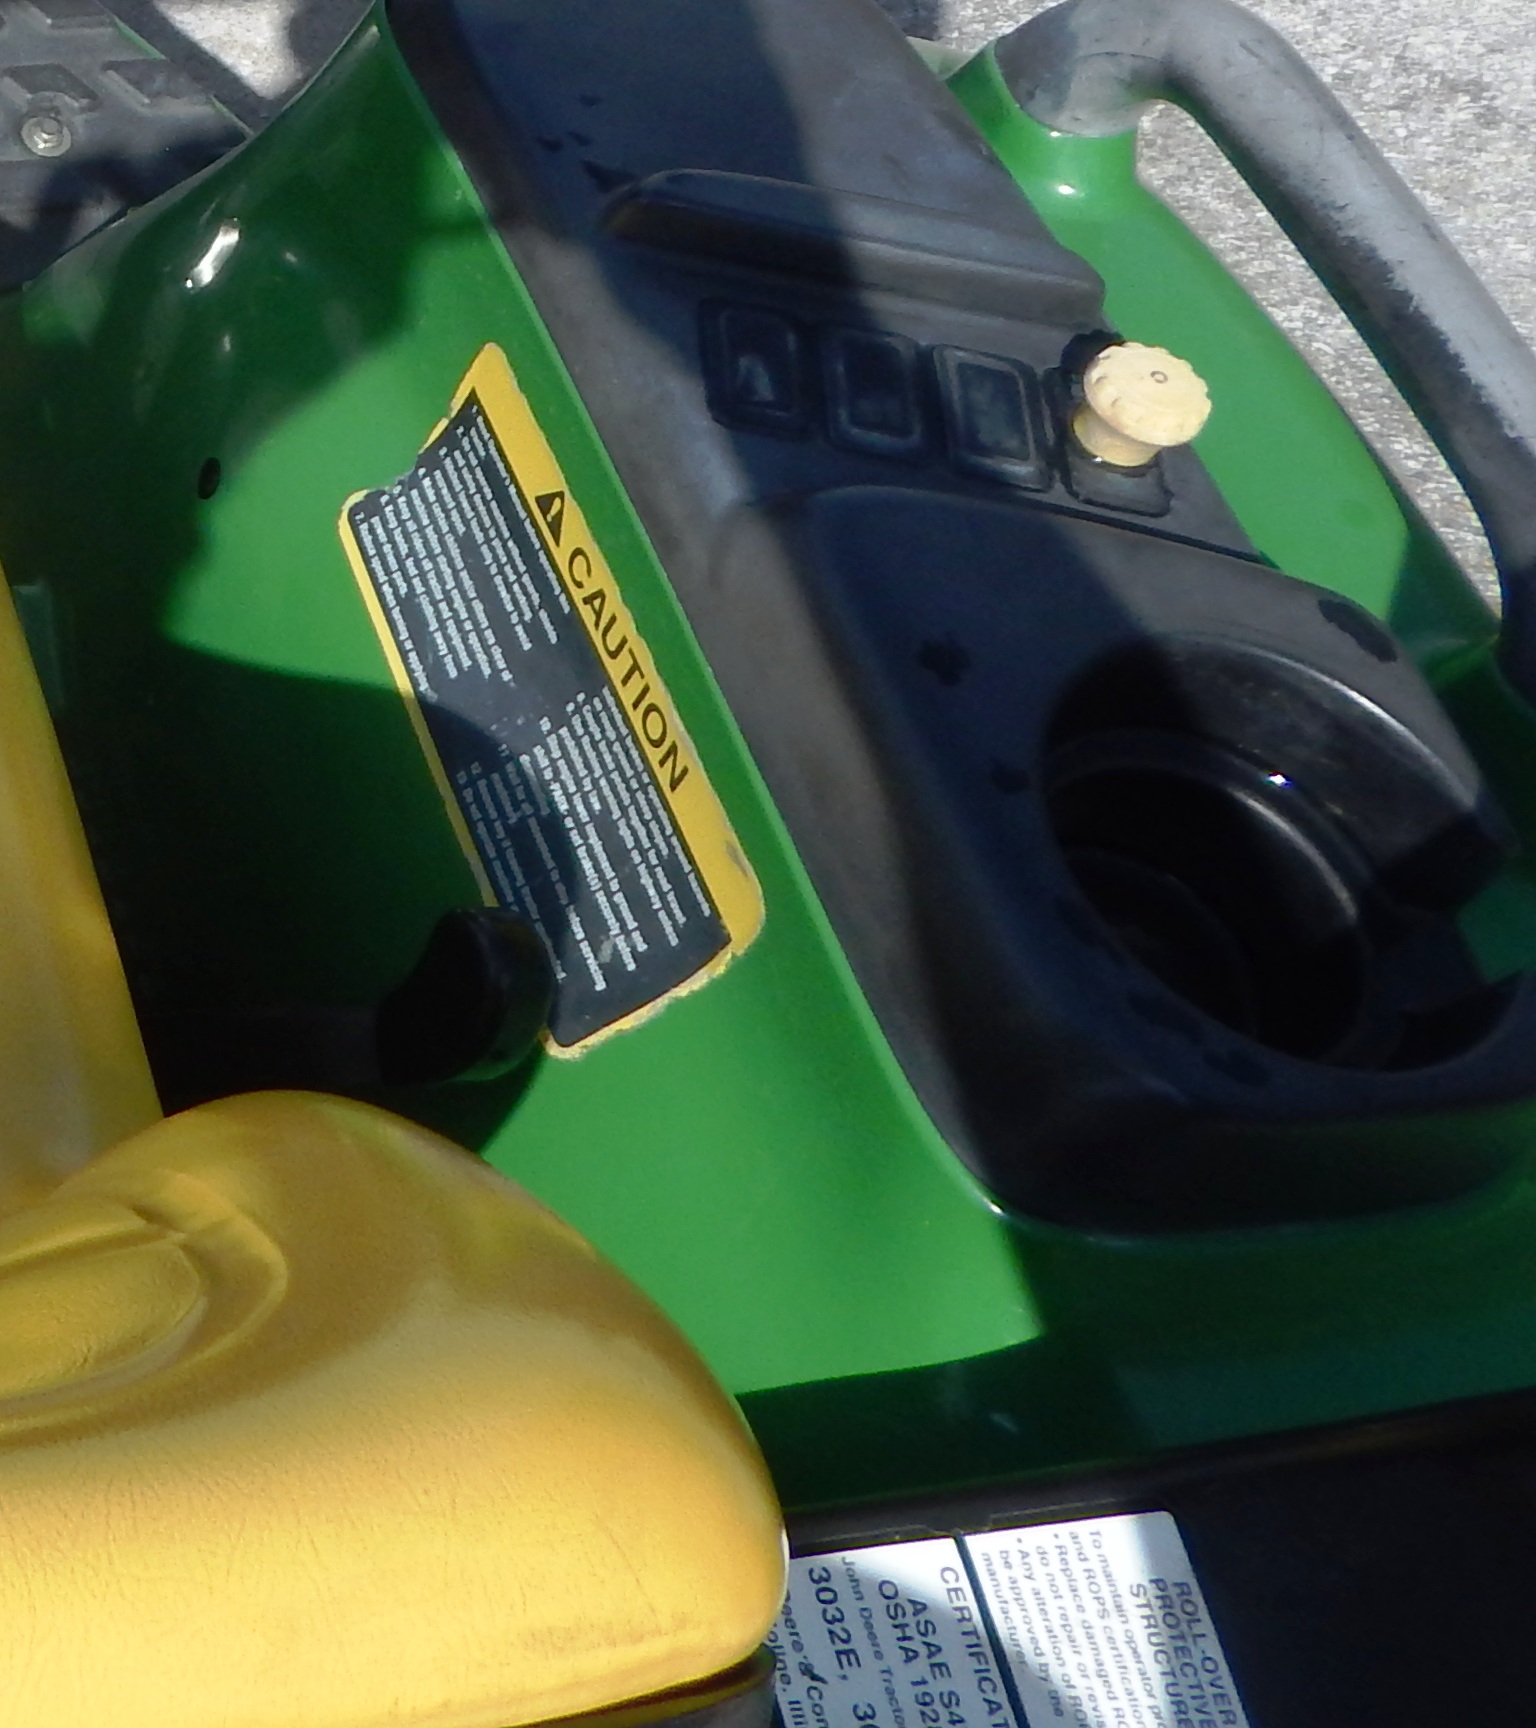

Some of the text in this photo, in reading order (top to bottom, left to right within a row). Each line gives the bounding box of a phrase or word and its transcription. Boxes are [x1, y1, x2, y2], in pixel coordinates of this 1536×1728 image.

[568, 547, 689, 793] CAUTION
[998, 1548, 1015, 1570] be
[1068, 1528, 1089, 1563] and
[1081, 1565, 1111, 1621] ROPS
[1088, 1527, 1105, 1550] To
[775, 1588, 806, 1654] eere
[806, 1562, 864, 1682] 3032E,
[840, 1554, 867, 1603] John
[857, 1605, 886, 1663] Deere
[875, 1577, 922, 1665] OSHA
[1005, 1573, 1046, 1658] approved
[1016, 1547, 1038, 1583] Any
[1029, 1585, 1068, 1668] alteration
[1060, 1671, 1076, 1690] of
[1034, 1543, 1052, 1567] do
[1044, 1570, 1064, 1600] not
[1054, 1604, 1083, 1657] repair
[1075, 1661, 1091, 1681] or
[1053, 1542, 1089, 1615] Replace
[1080, 1616, 1120, 1702] damaged
[1096, 1551, 1131, 1625] maintain
[764, 1620, 795, 1693] oline,
[906, 1594, 952, 1682] ASAE
[1120, 1627, 1157, 1701] operator
[1127, 1580, 1193, 1728] STRUCTURE
[1171, 1579, 1237, 1728] ROLL-OVER
